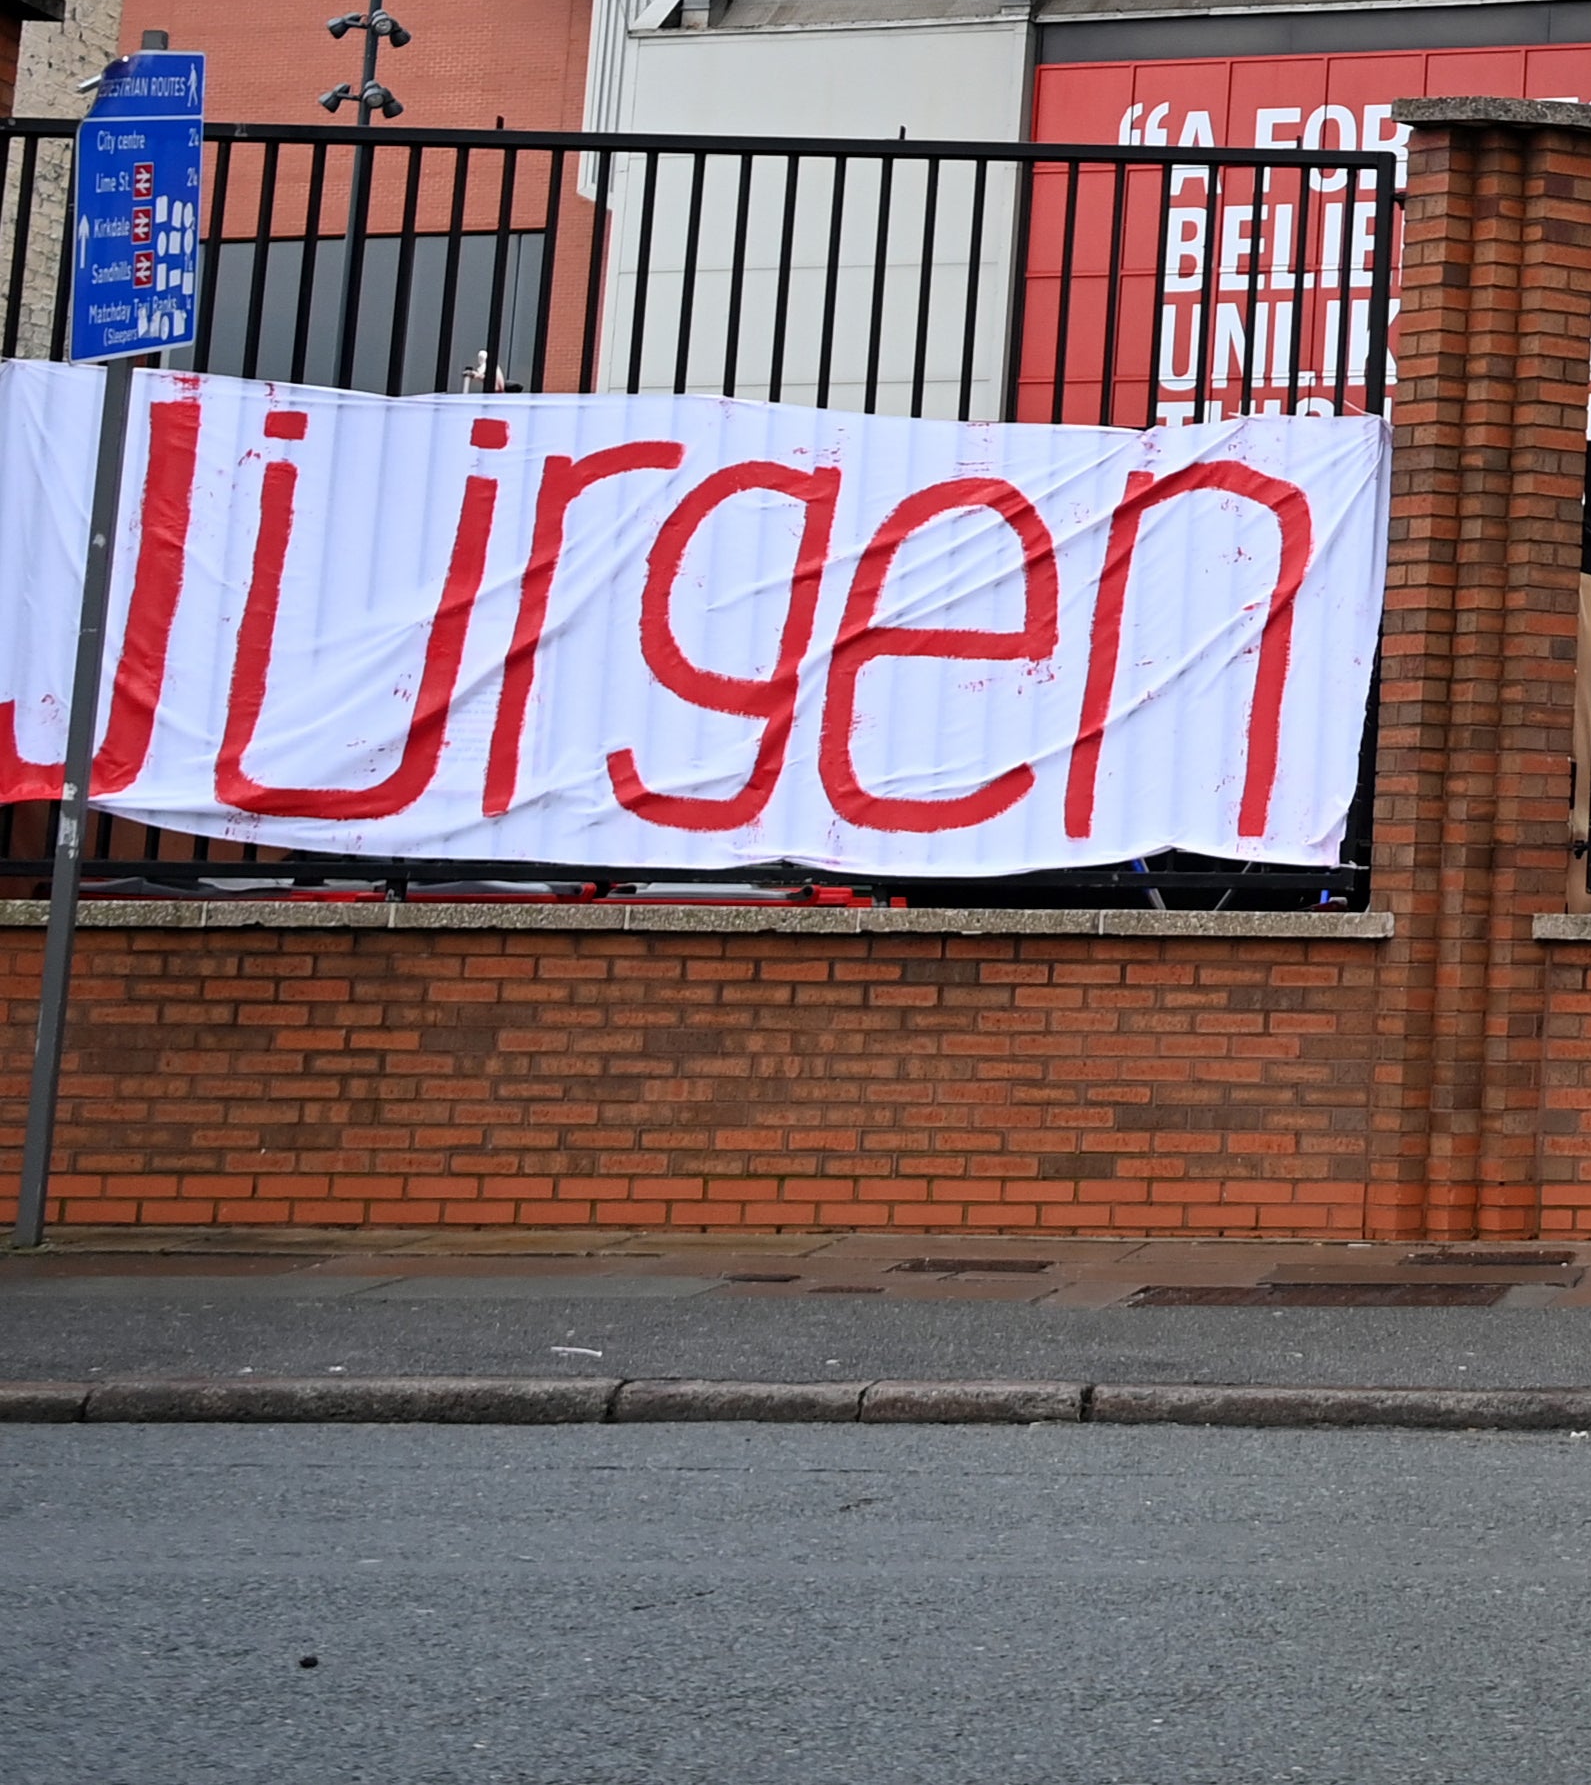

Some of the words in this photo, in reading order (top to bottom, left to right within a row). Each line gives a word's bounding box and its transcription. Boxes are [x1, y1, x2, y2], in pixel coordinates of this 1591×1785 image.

[152, 76, 187, 97] ROUTES
[97, 130, 116, 154] City
[117, 130, 145, 149] centre
[95, 172, 117, 193] Lime
[93, 216, 131, 239] Kirkdale
[1163, 199, 1405, 293] BELIE
[91, 260, 133, 284] Sandhills
[88, 300, 131, 325] Matchday
[1158, 297, 1400, 392] UNLIK
[0, 400, 1311, 839] Jürgen
